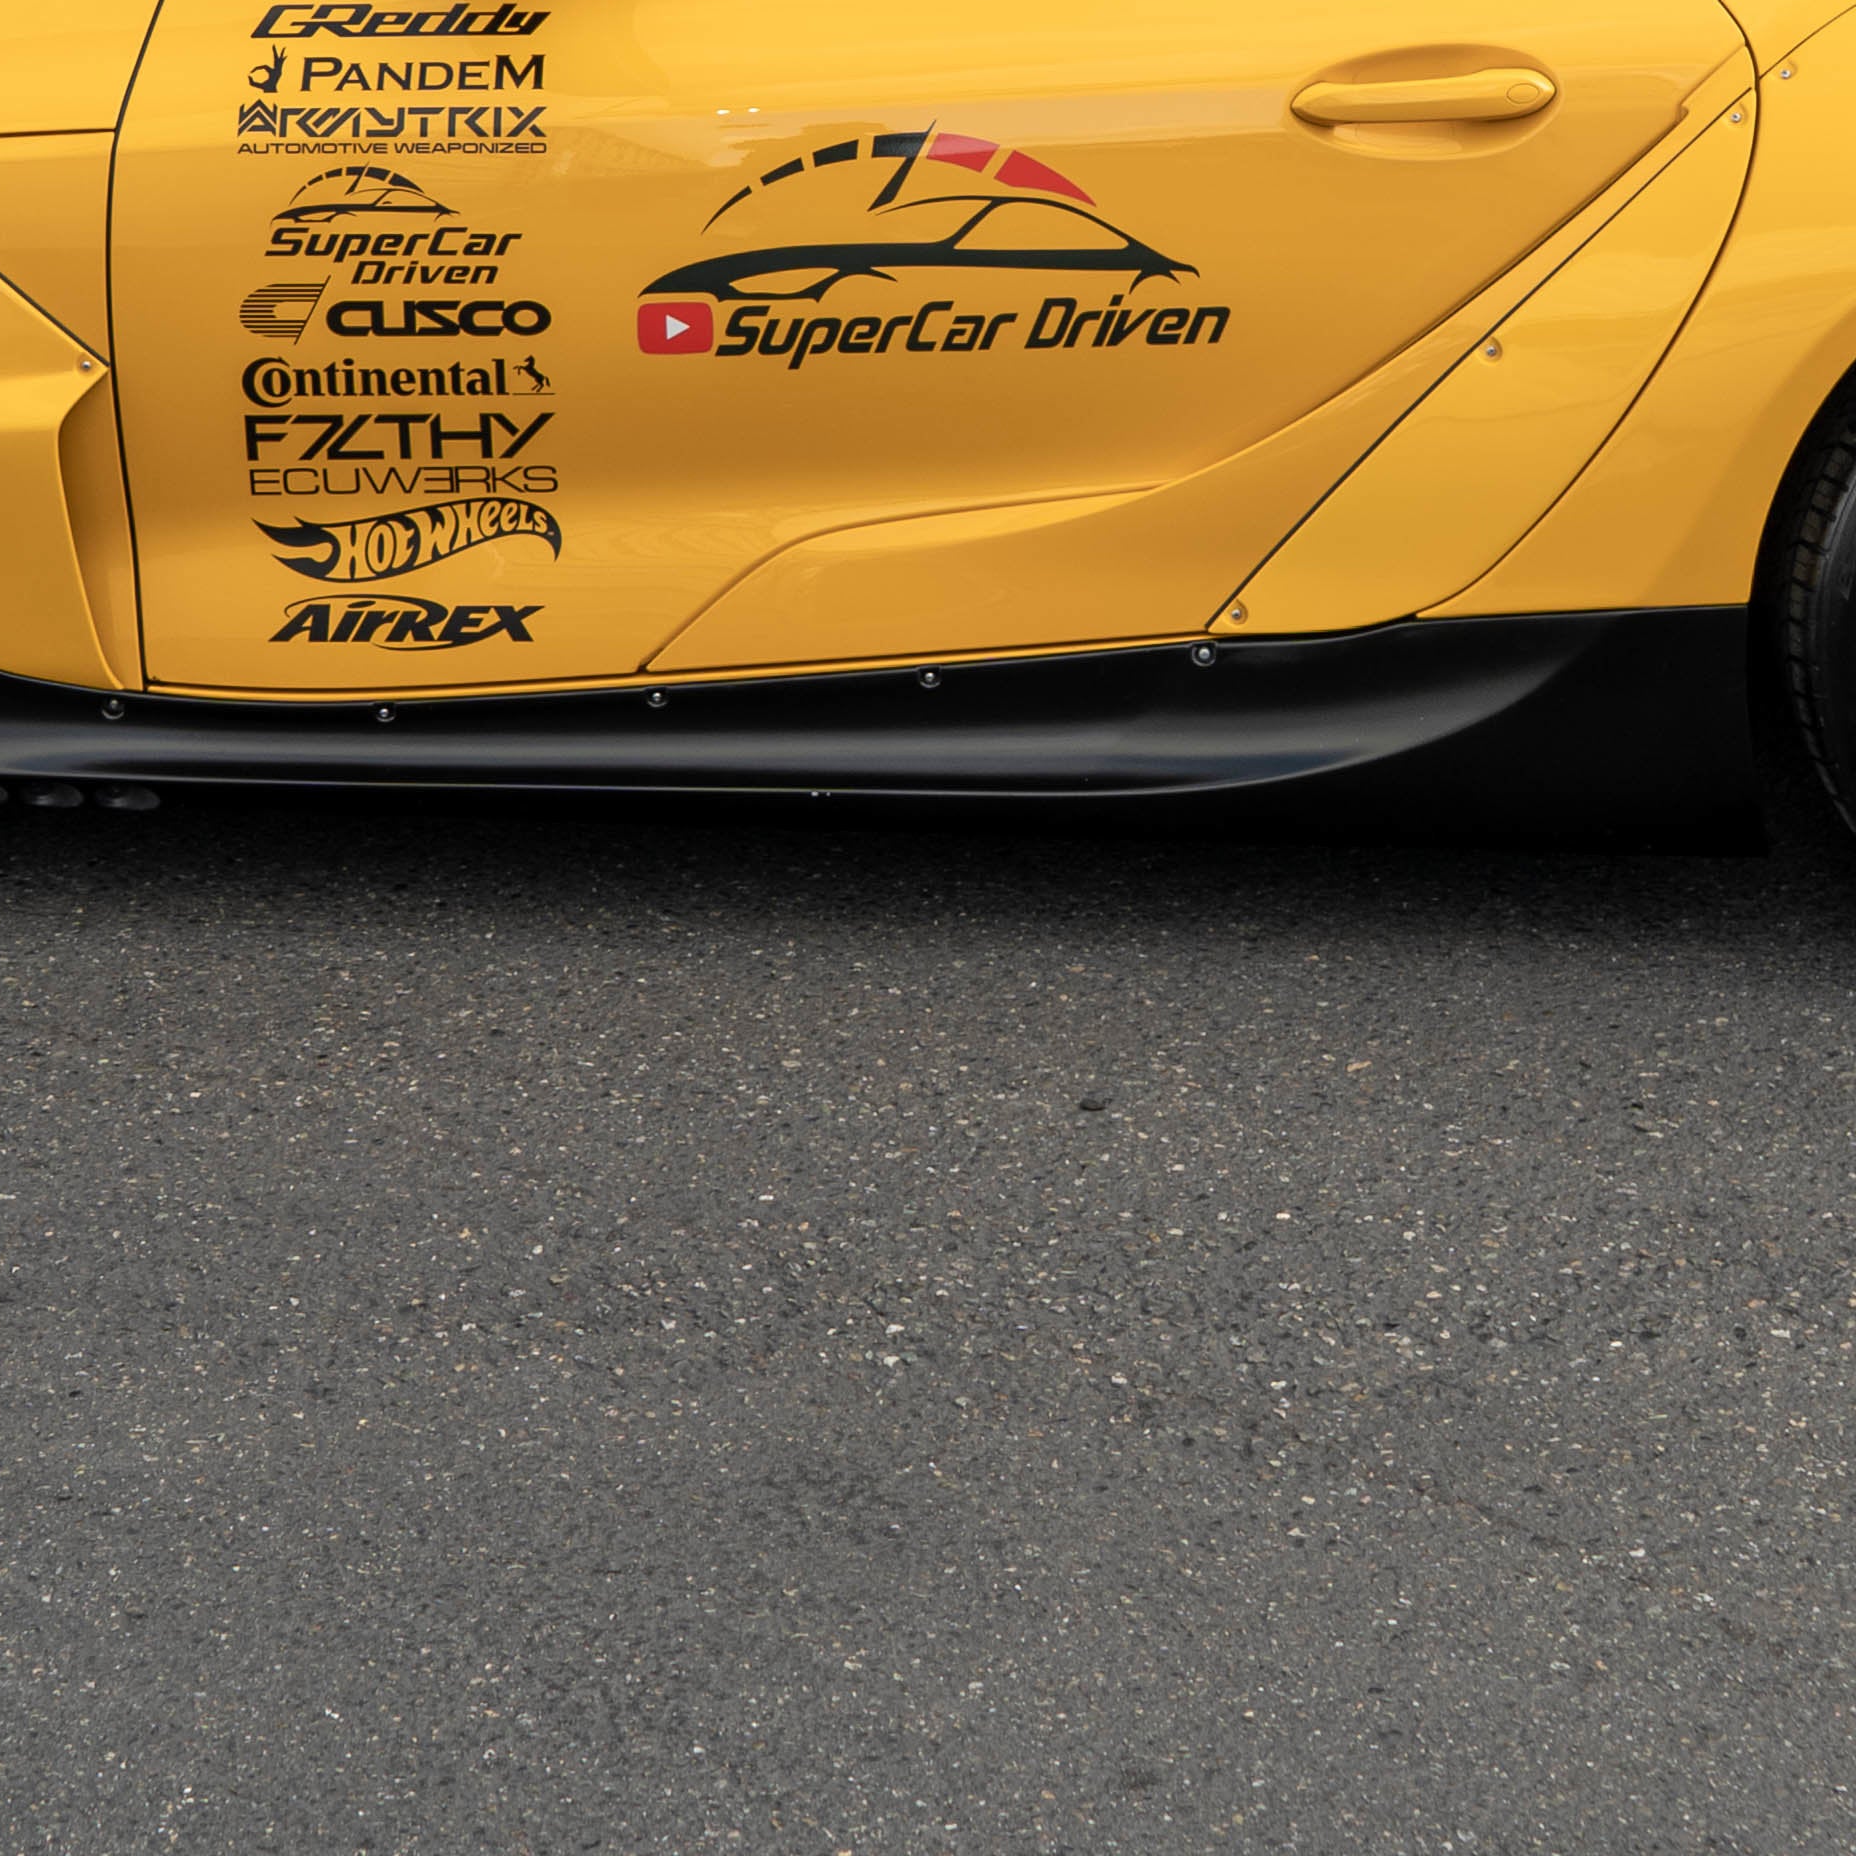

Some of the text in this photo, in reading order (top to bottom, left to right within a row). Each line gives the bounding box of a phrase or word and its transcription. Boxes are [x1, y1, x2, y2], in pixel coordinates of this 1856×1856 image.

[250, 3, 552, 39] GReddy
[237, 142, 547, 154] AUTOMOTIVE WEAPONIZED
[264, 226, 523, 263] SuperCar
[350, 260, 499, 285] Driven
[325, 300, 552, 337] CUSCO
[714, 294, 1232, 371] SuperCar Driven
[241, 356, 511, 409] Continental
